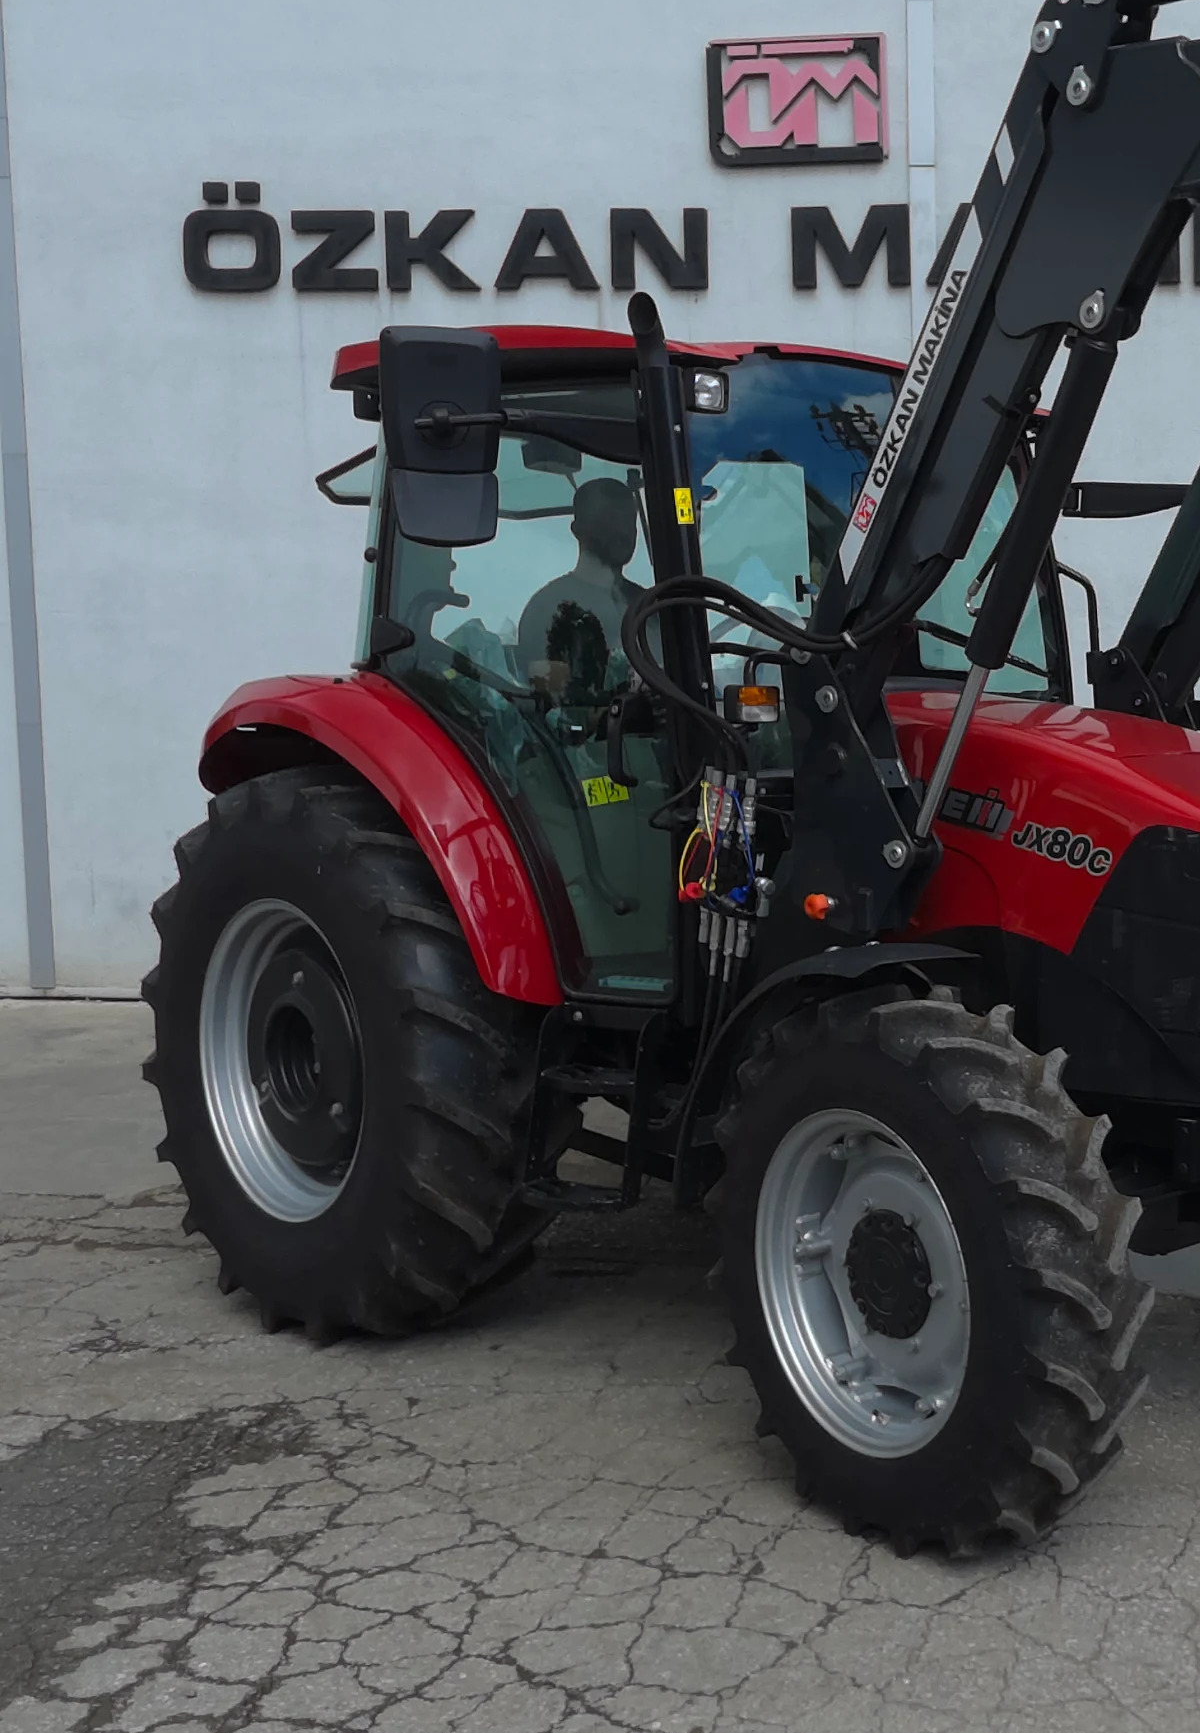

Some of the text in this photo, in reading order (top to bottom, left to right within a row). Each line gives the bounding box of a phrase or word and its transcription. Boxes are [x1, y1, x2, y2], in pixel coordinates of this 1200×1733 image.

[182, 181, 710, 293] ÖZKAN
[871, 394, 919, 489] ÖZKAN
[913, 268, 968, 386] MAKİNA
[1011, 820, 1113, 876] JX80C
